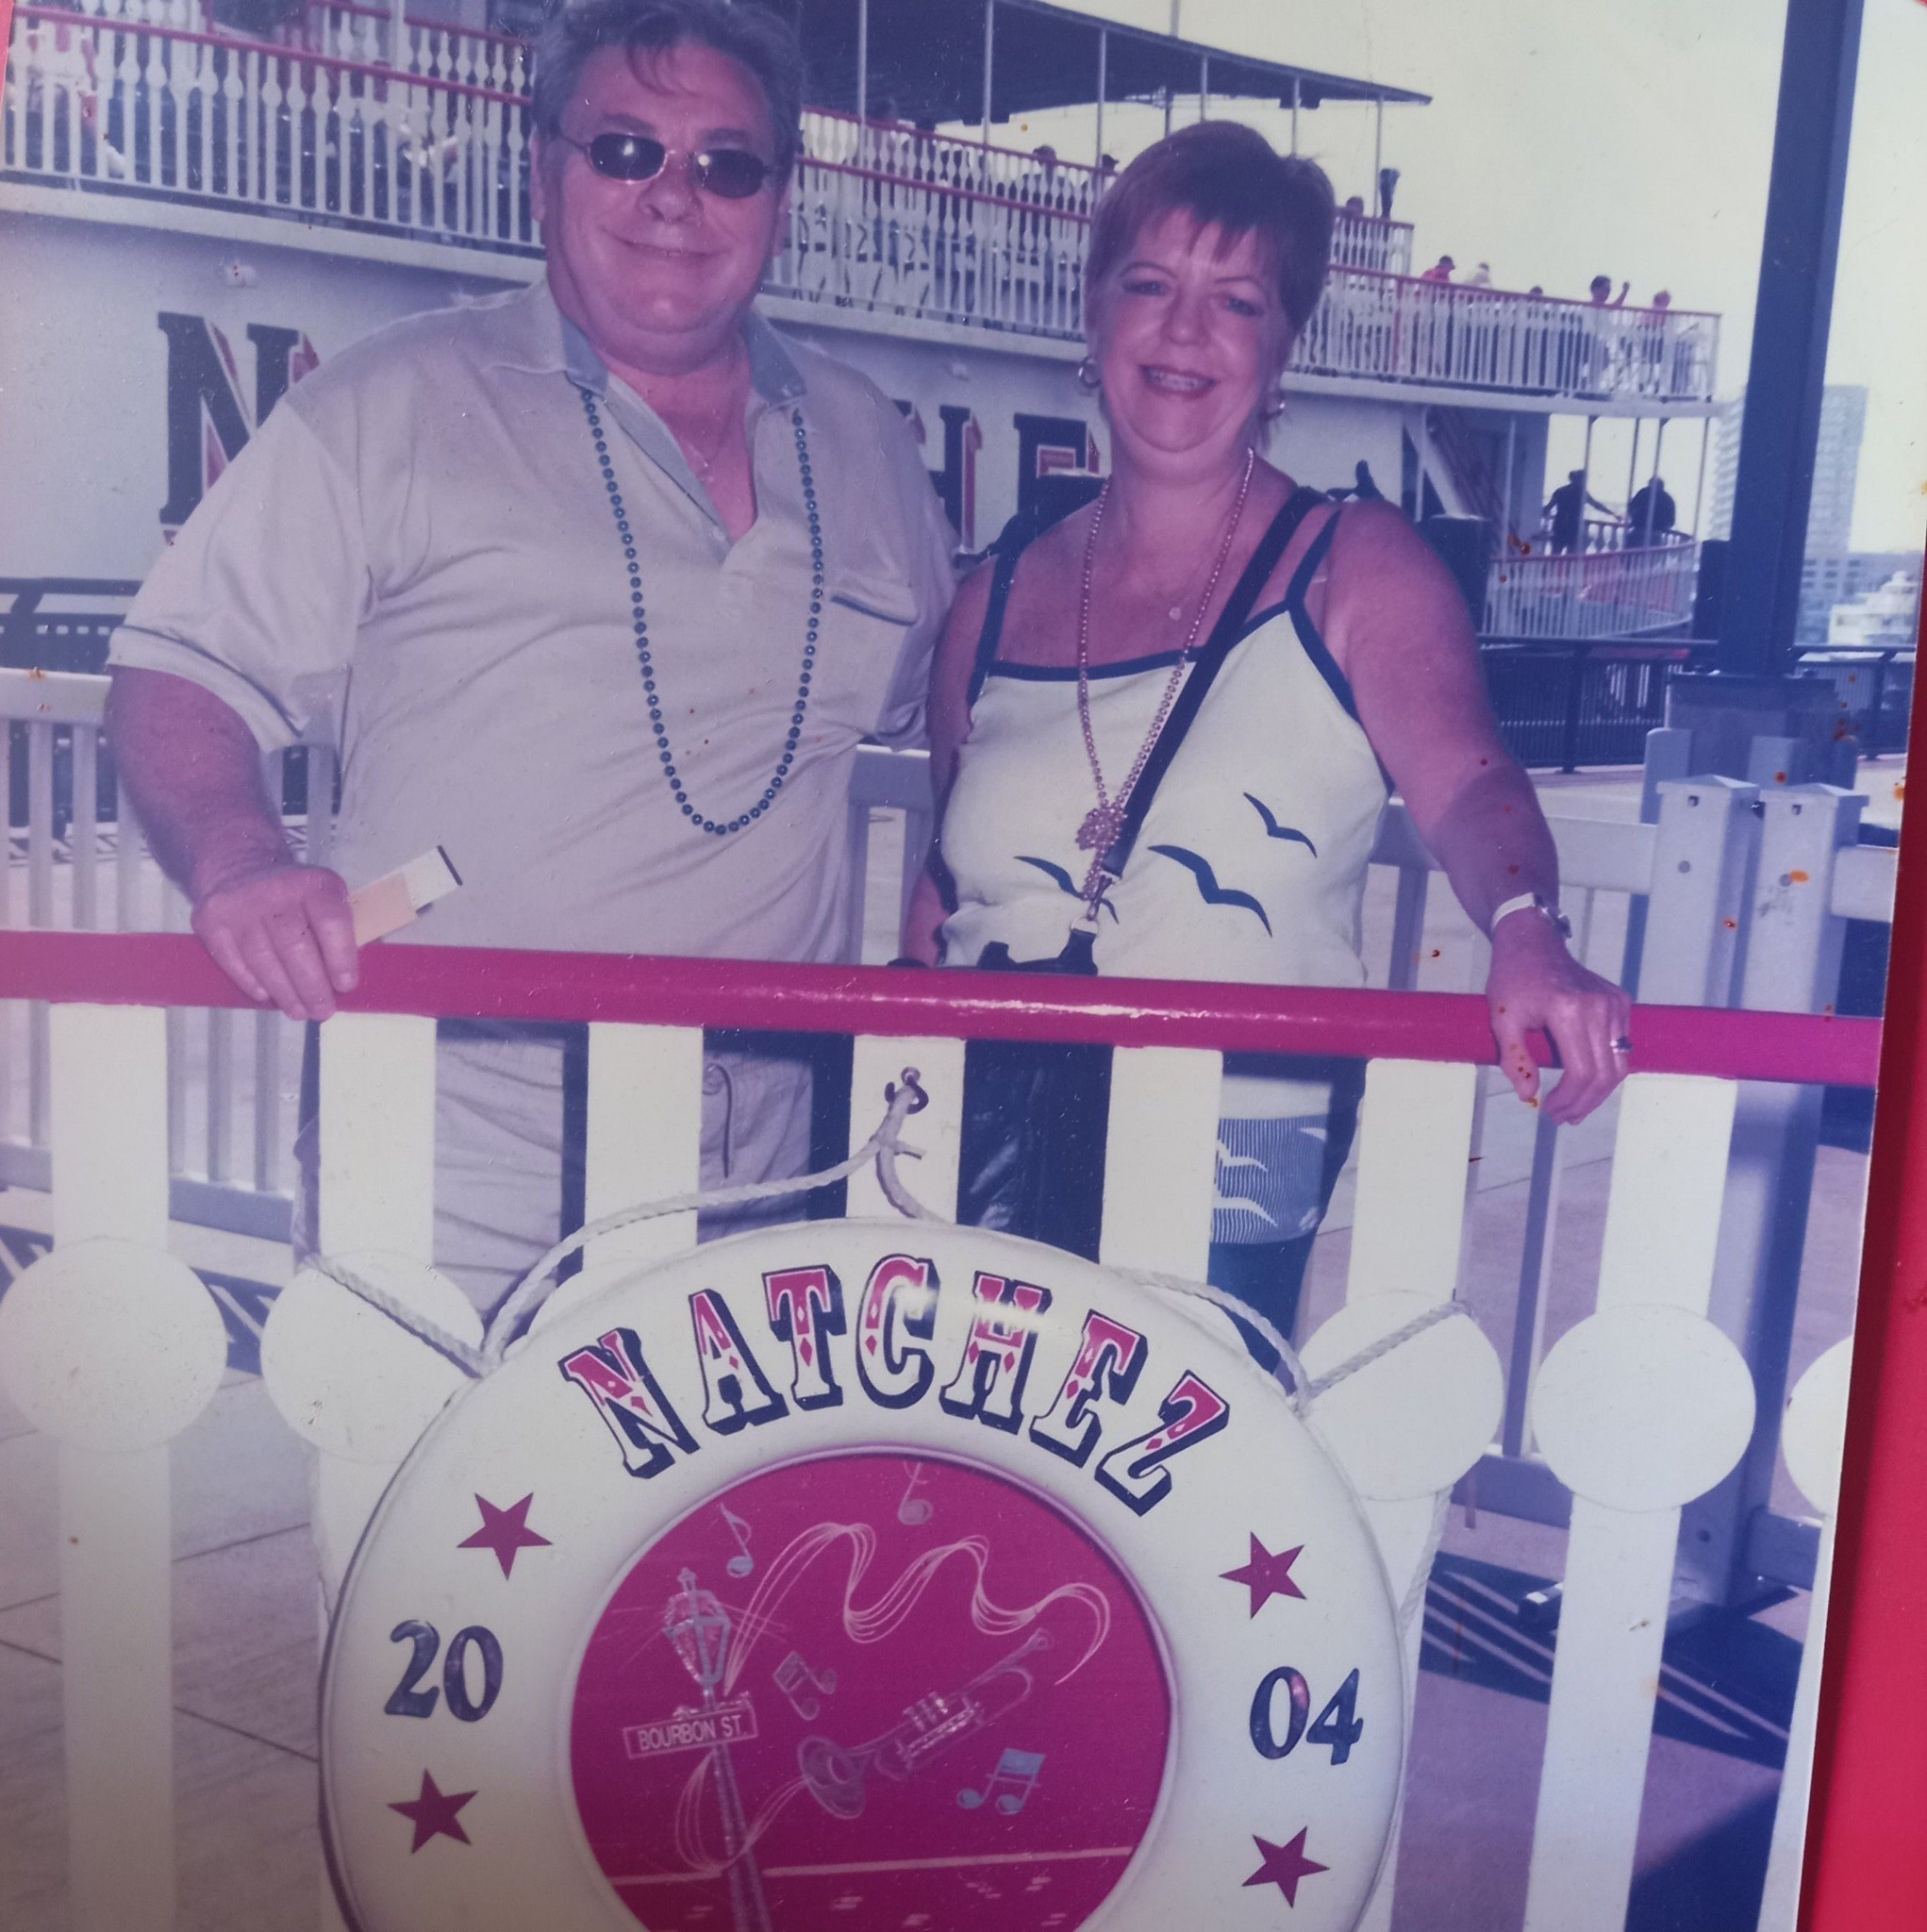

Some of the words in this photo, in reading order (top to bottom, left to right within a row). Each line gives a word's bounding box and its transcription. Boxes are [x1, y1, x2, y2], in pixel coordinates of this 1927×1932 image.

[557, 1253, 1231, 1517] NATCHEZ
[385, 1619, 504, 1723] 20
[1249, 1665, 1364, 1766] 04
[638, 1720, 717, 1752] BOURBON
